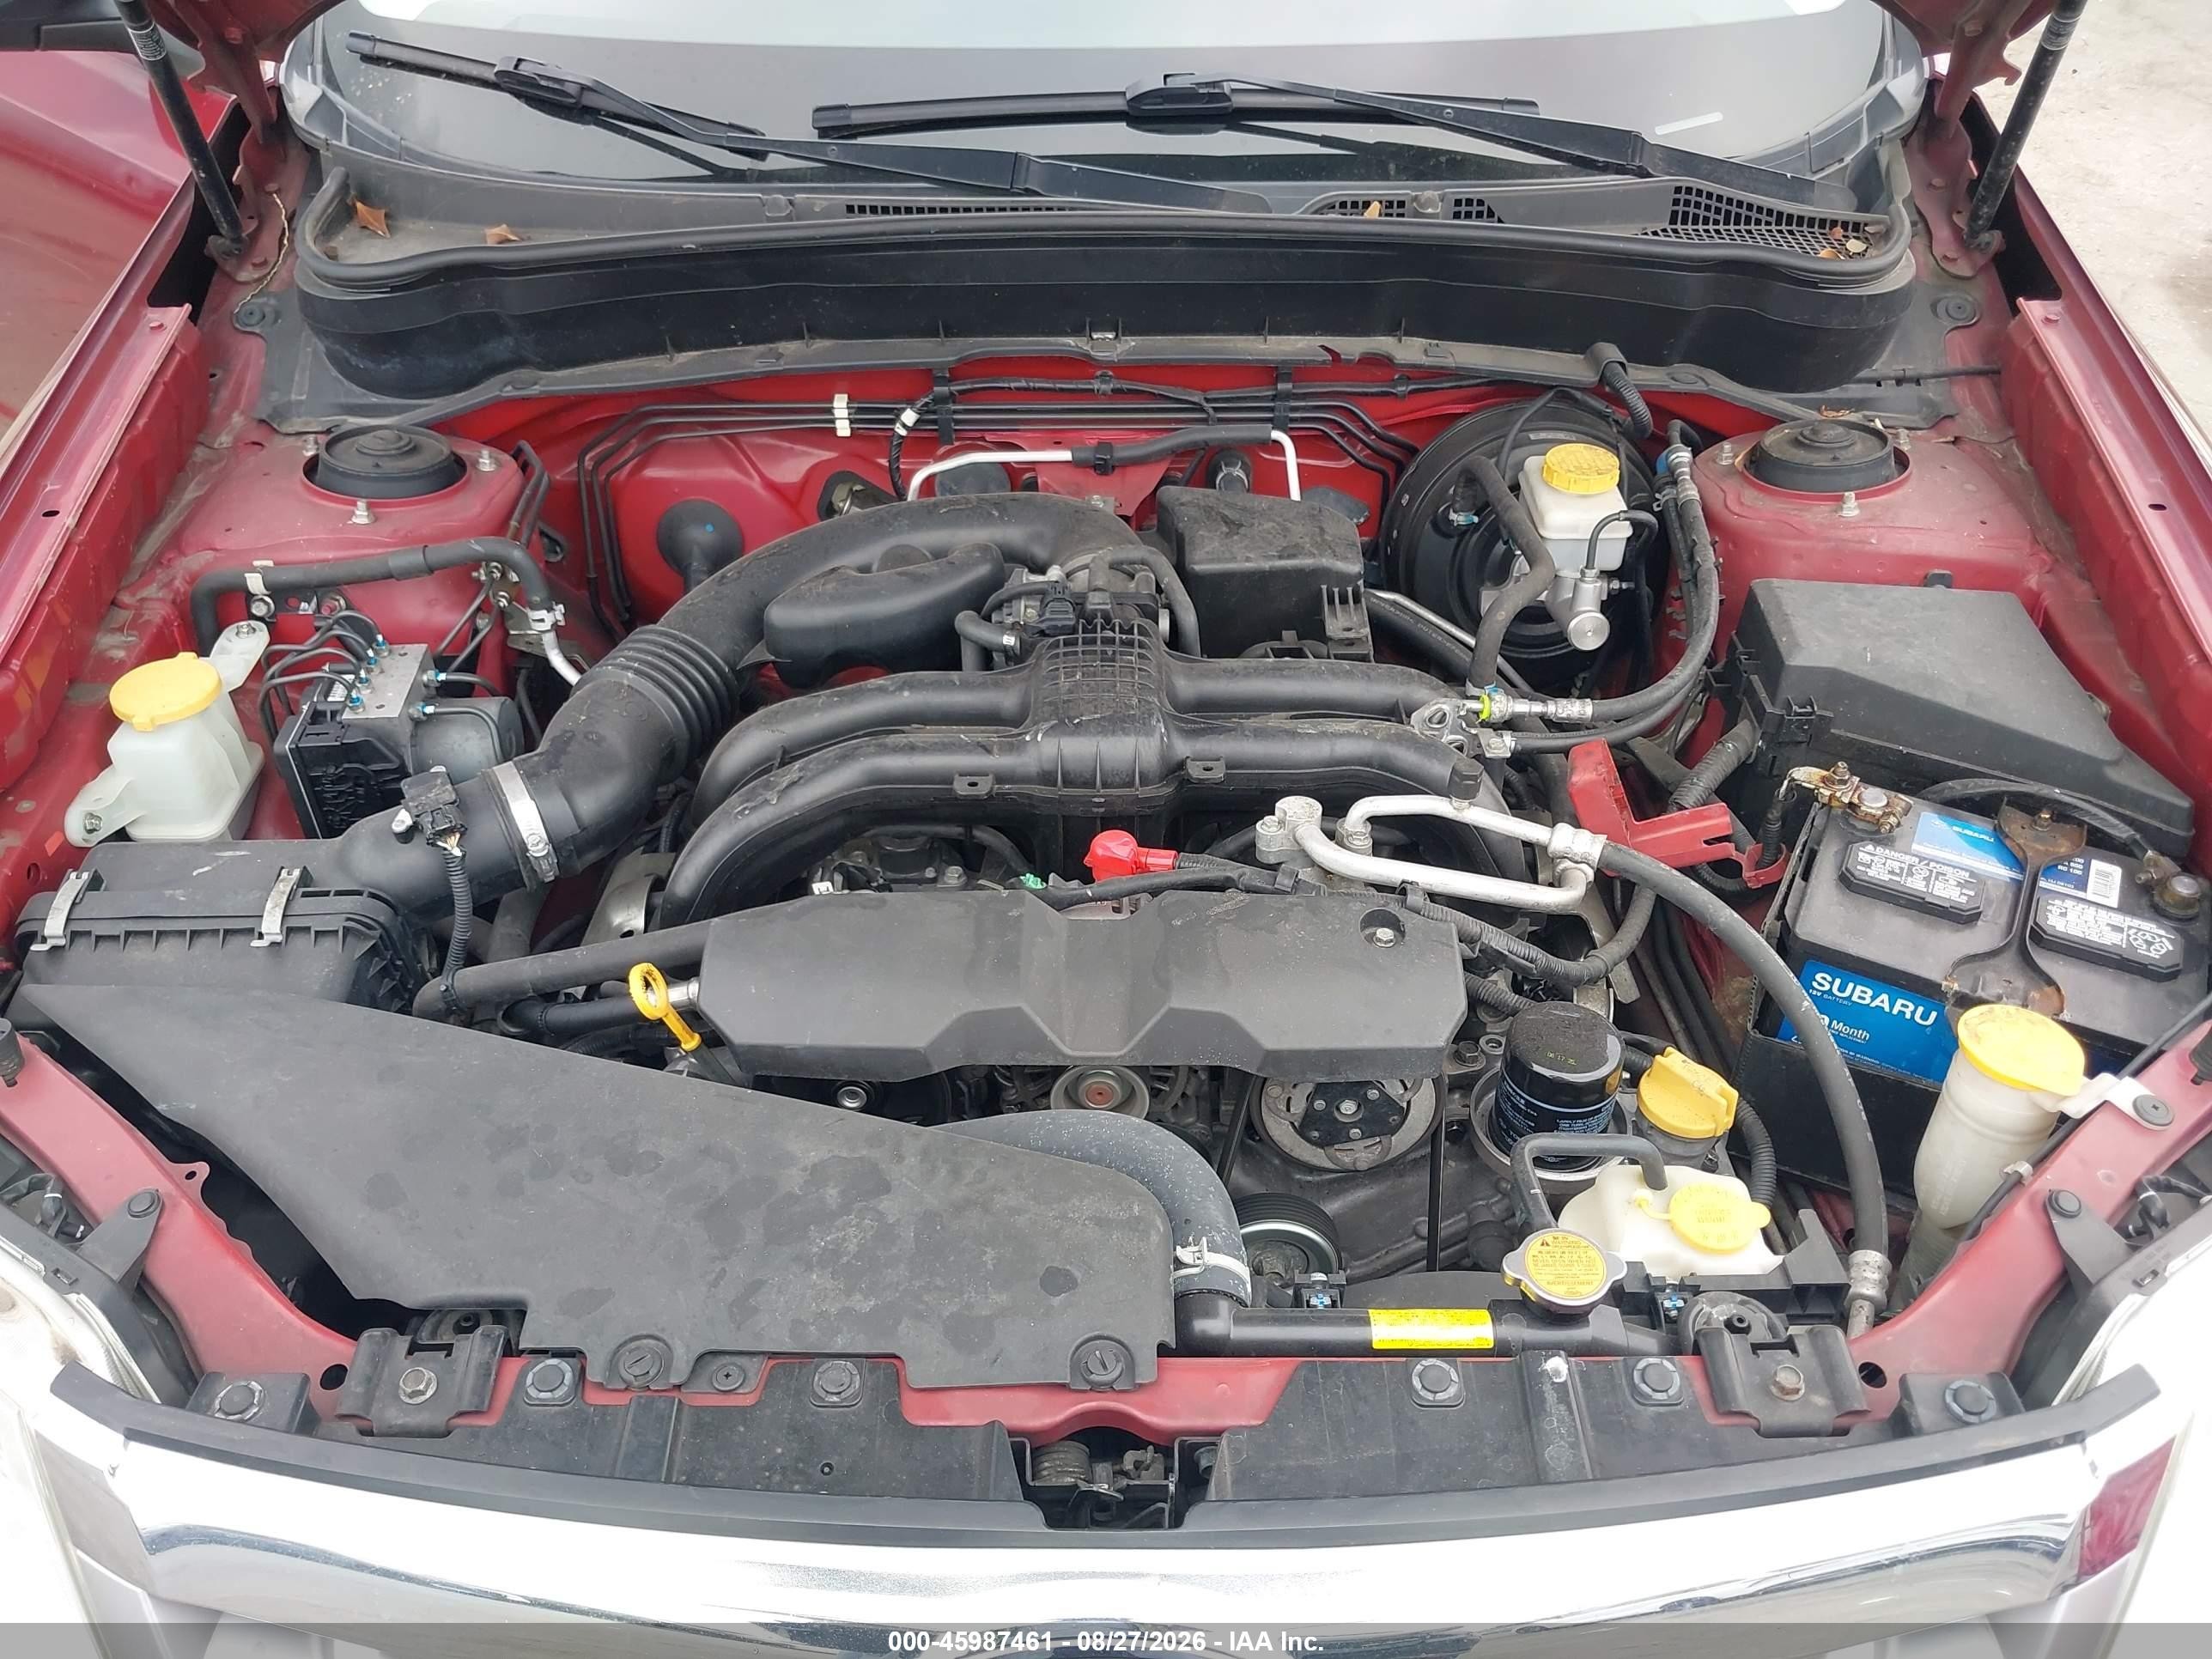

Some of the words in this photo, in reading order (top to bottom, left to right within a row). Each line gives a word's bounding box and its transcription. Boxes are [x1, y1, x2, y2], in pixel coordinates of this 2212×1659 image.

[1875, 846, 1920, 865] DANGER
[1929, 861, 1970, 878] POISON
[1809, 988, 1821, 997] 12V
[1822, 994, 1853, 1006] BATTERY
[1811, 972, 1938, 1026] SUBARU
[1831, 1019, 1870, 1041] Month
